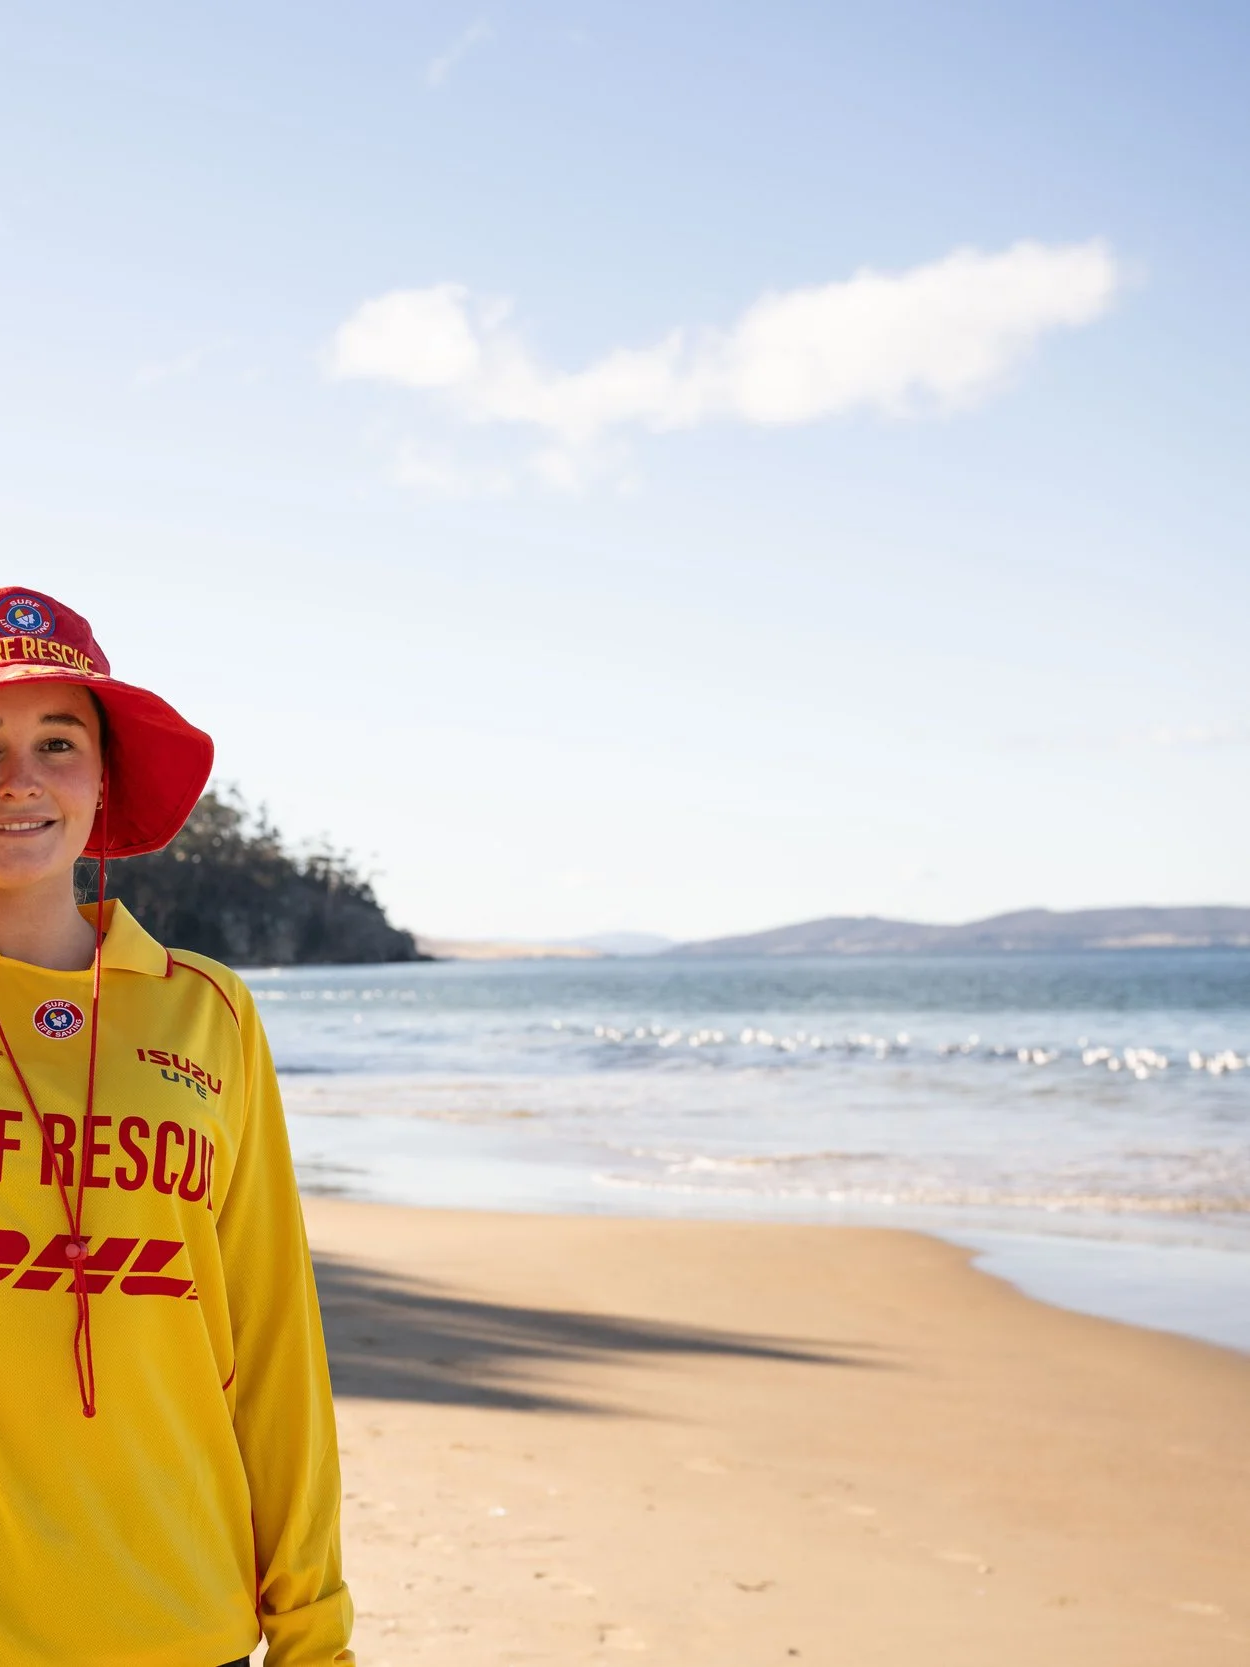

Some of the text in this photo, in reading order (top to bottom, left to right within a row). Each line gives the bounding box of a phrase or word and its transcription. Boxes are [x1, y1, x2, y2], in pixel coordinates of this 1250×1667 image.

[10, 599, 40, 608] SURF
[0, 619, 18, 634] LIFE
[44, 1001, 71, 1010] SURF
[36, 1018, 83, 1037] LIFE SAVING
[136, 1048, 223, 1095] ISUZU
[160, 1068, 207, 1100] UTE
